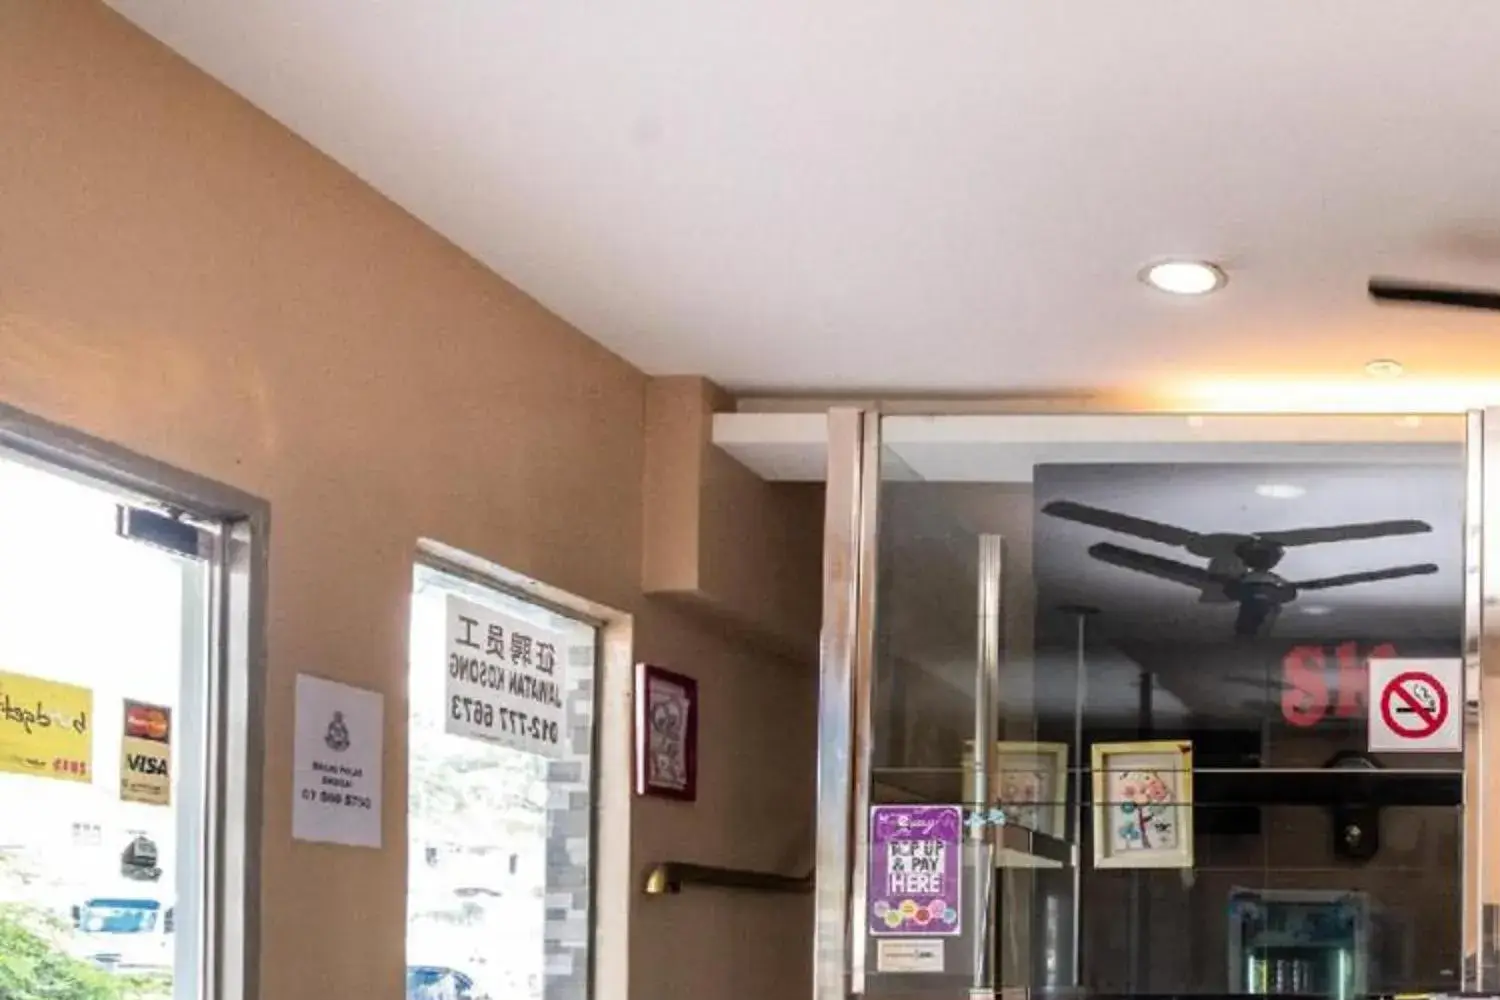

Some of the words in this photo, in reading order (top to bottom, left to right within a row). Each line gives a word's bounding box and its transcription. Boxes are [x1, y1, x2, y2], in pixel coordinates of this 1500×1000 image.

[127, 752, 168, 777] VISA
[911, 858, 939, 871] PAY
[891, 874, 941, 893] HERE
